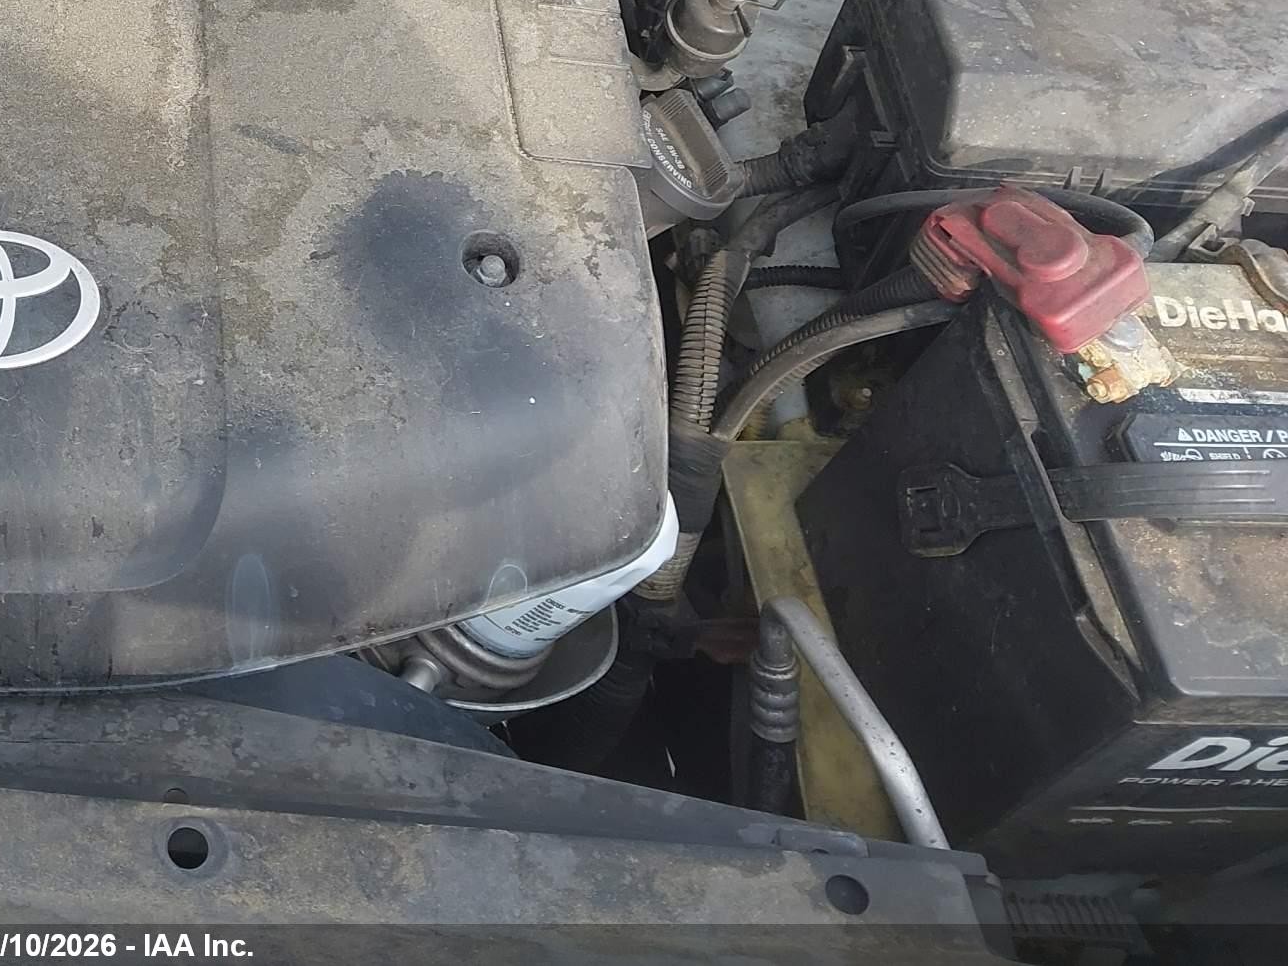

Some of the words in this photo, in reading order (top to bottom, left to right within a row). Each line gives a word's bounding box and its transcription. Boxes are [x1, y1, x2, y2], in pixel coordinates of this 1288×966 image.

[1153, 296, 1288, 332] DieHa
[1192, 428, 1263, 443] DANGER
[1118, 777, 1226, 786] POWER
